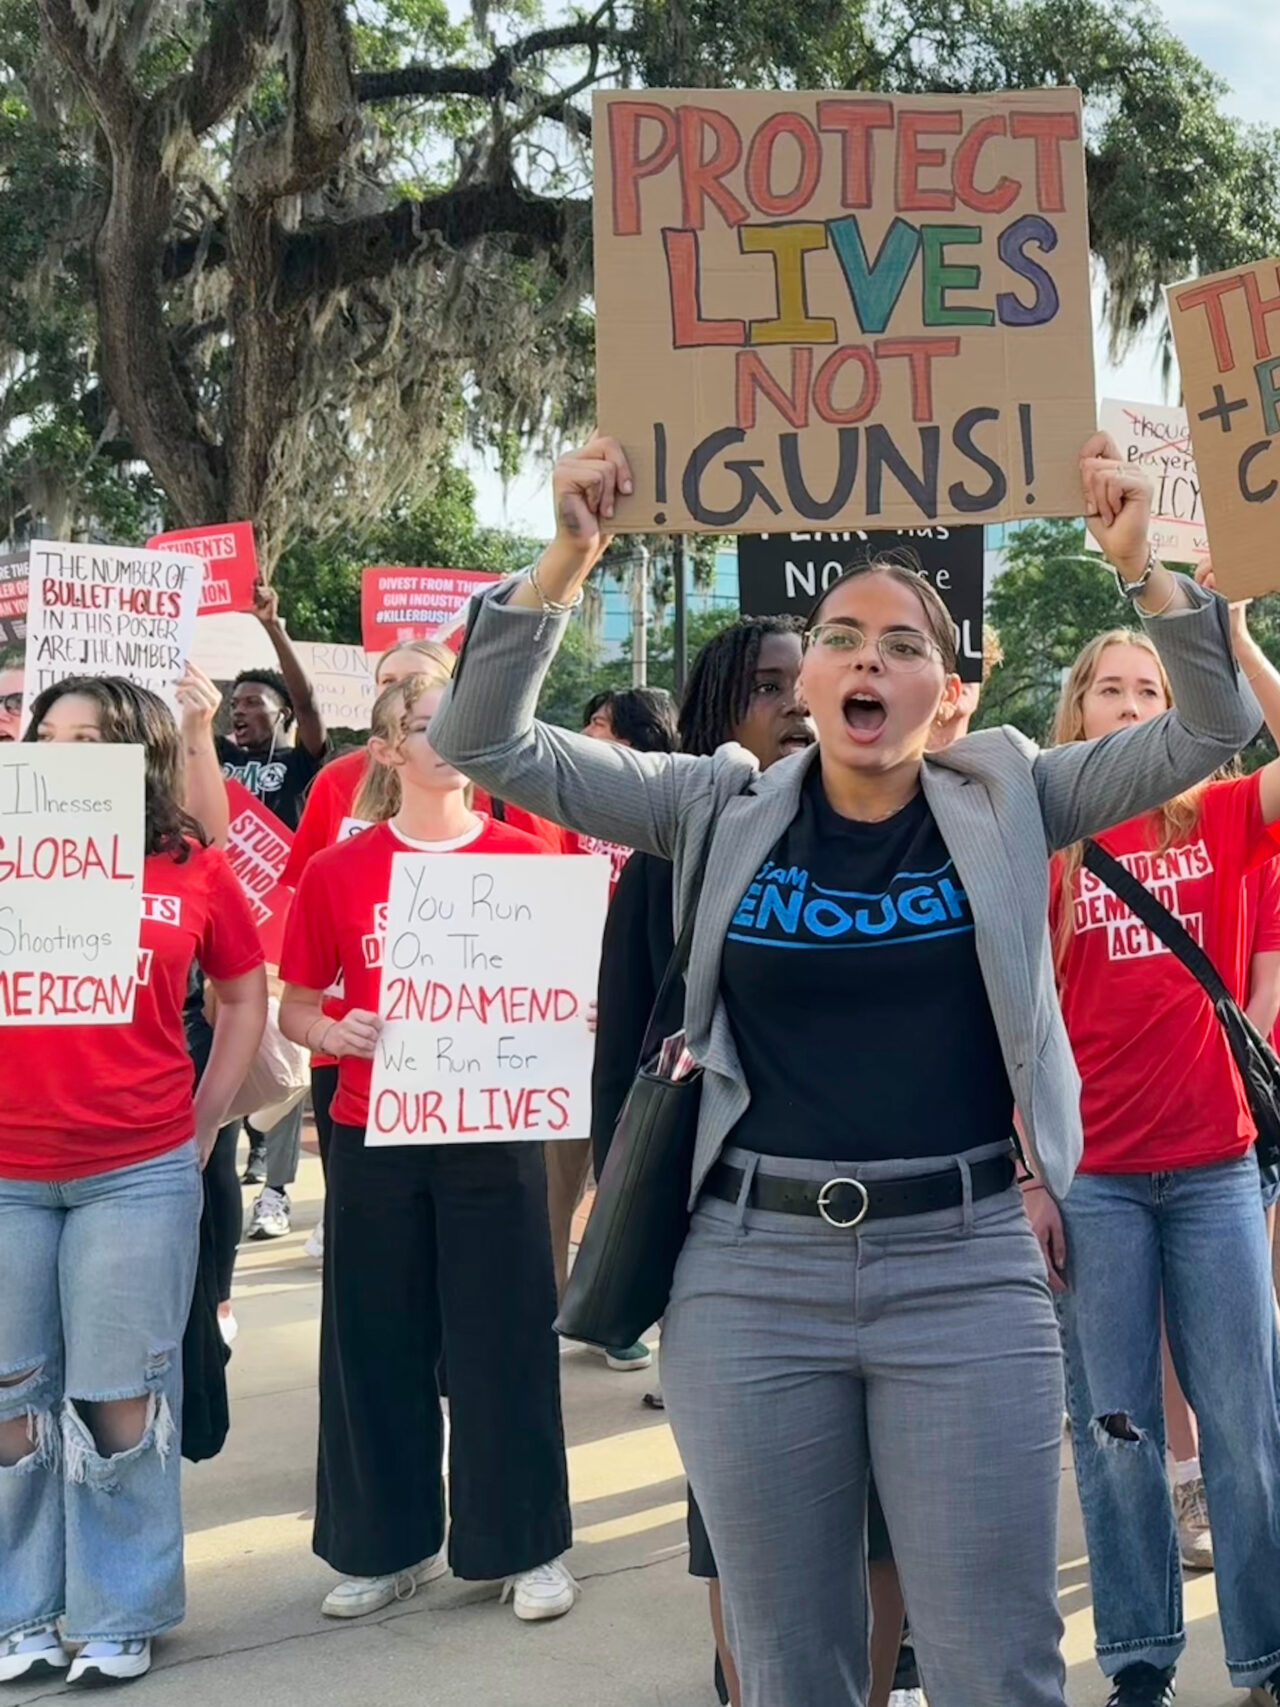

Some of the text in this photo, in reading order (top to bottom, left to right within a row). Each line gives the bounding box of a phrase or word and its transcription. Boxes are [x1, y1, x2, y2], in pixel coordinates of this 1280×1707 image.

[607, 100, 1079, 236] PROTECT
[661, 214, 1060, 348] LIVES
[735, 336, 960, 430] NOT
[36, 552, 89, 581] THE
[92, 556, 162, 588] NUMBER
[165, 563, 195, 590] OF
[378, 577, 418, 590] DIVEST
[420, 578, 453, 592] FROM
[42, 578, 116, 609] BULLET
[119, 587, 182, 618] HOLES
[43, 610, 178, 642] IN THIS POSTER
[37, 635, 182, 670] ARE THE NUMBER
[2, 763, 113, 815] Illnesses
[404, 865, 455, 922] You
[471, 873, 532, 922] Run
[391, 931, 434, 970] On
[447, 933, 503, 970] The
[381, 1035, 538, 1074] We Run For
[374, 1088, 447, 1135] OUR
